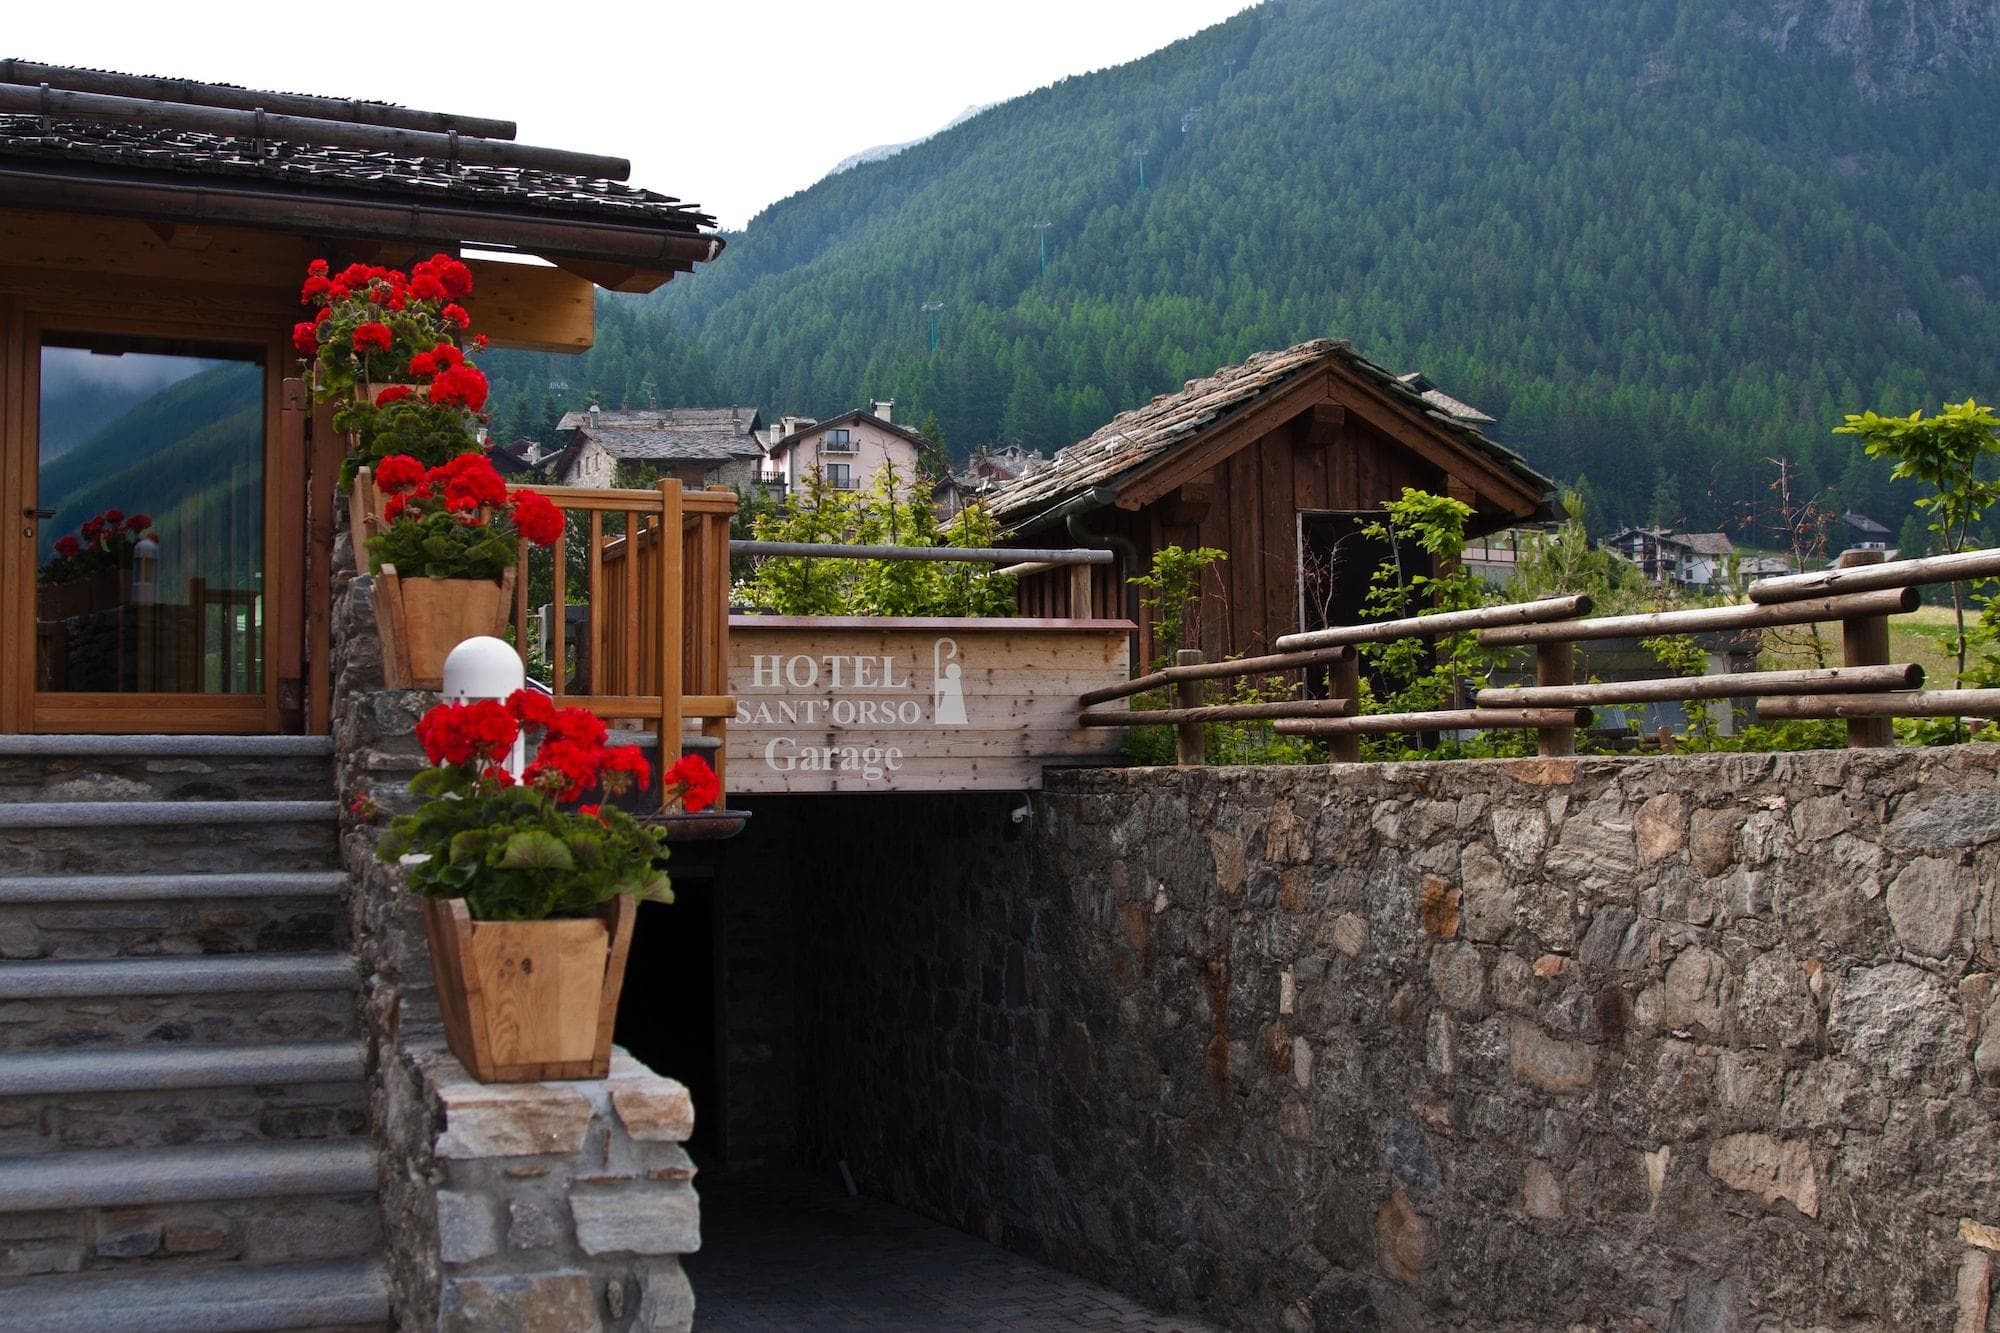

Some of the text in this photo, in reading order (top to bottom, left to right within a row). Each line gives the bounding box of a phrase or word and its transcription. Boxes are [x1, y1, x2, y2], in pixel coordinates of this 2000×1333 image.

[751, 654, 907, 688] HOTEL
[735, 699, 921, 725] SANT’ORSO
[765, 736, 903, 779] Garage
